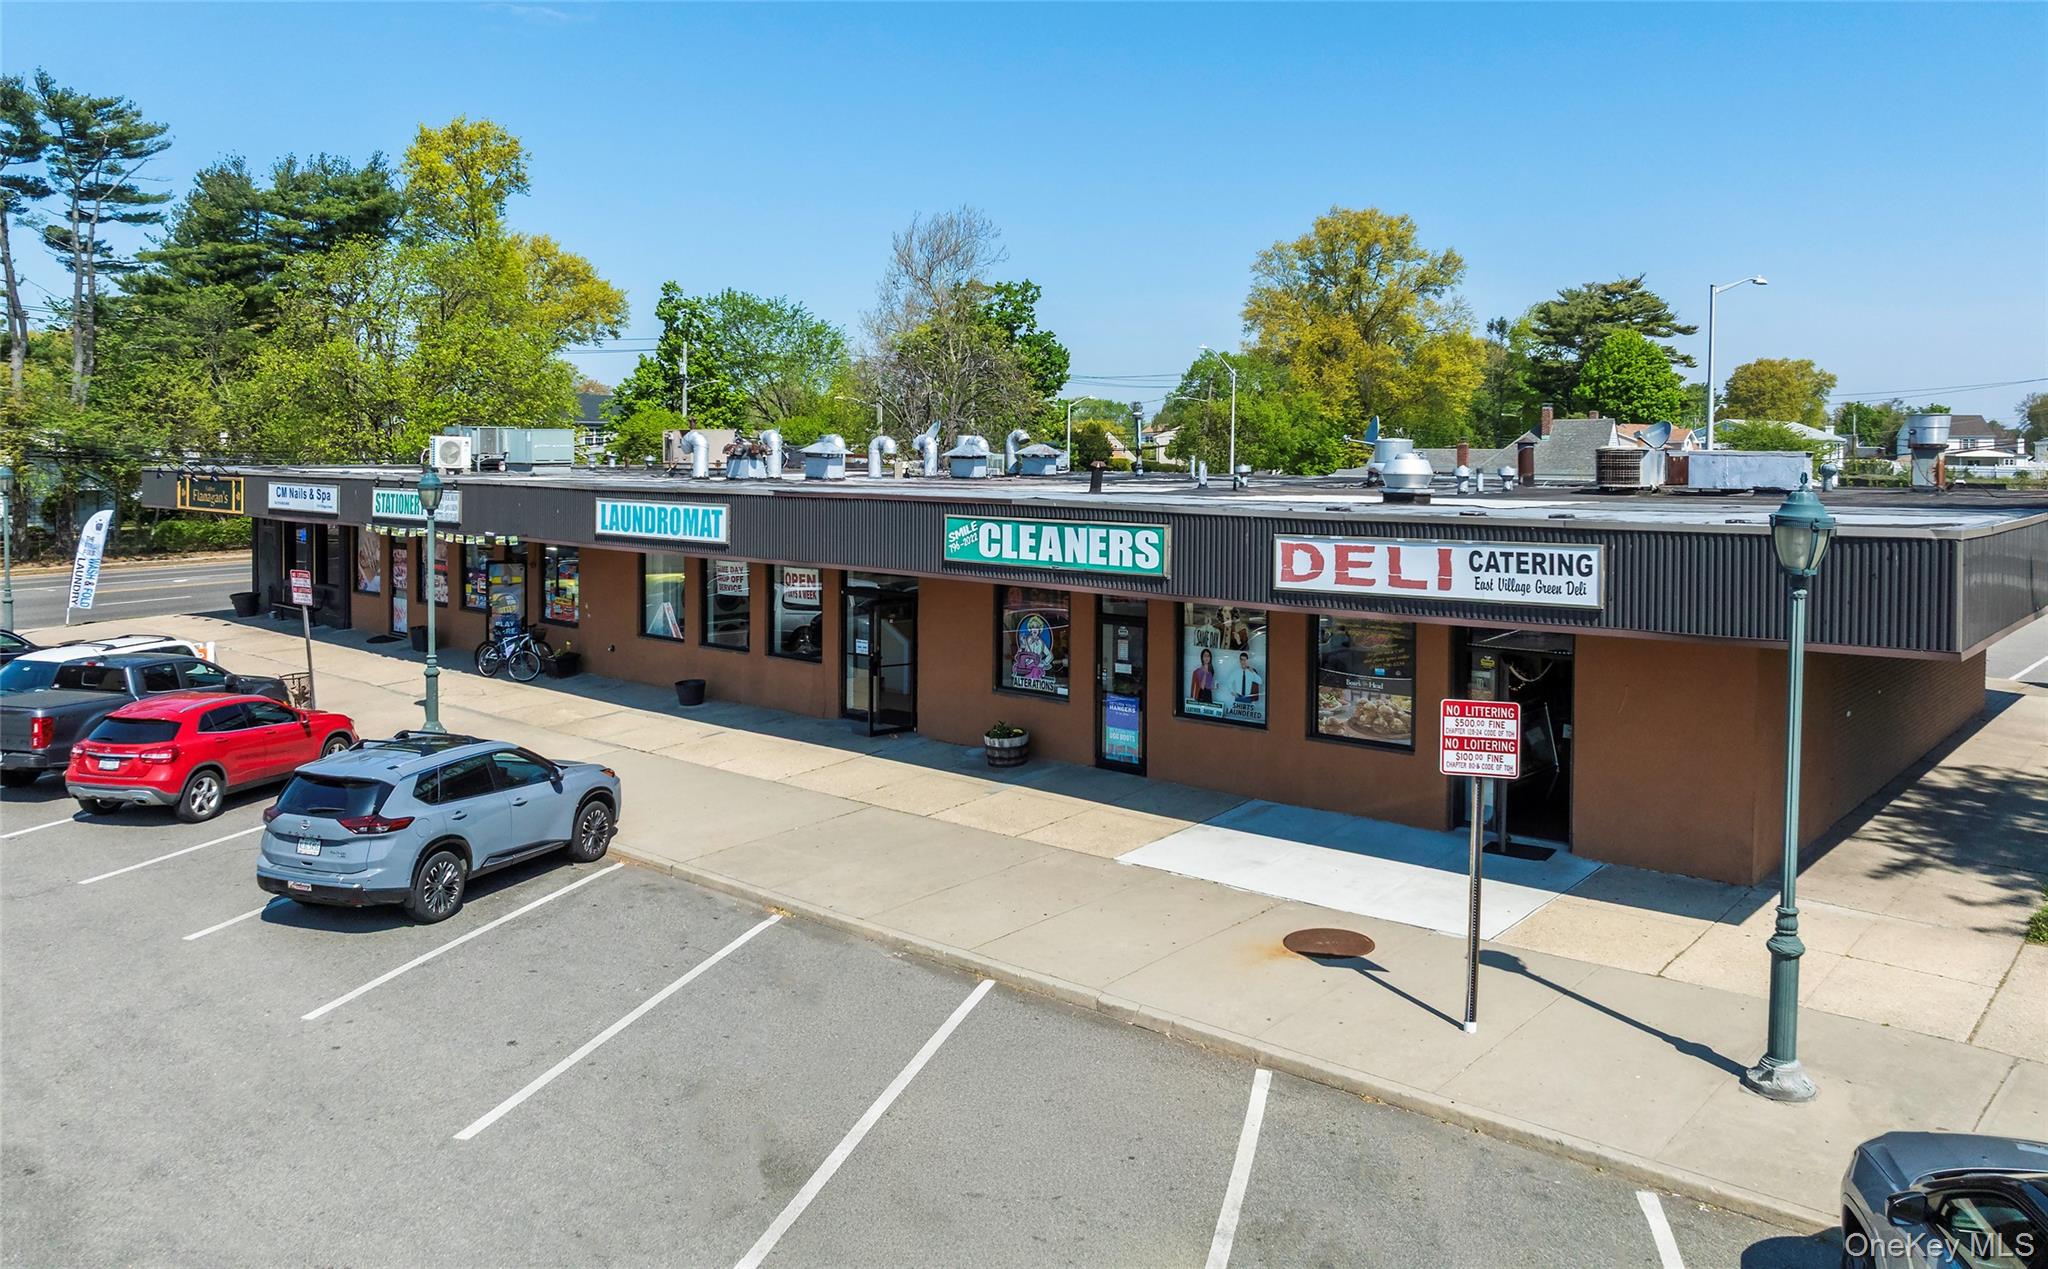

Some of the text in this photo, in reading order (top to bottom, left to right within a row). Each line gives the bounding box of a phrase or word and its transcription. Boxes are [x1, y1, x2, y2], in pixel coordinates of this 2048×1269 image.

[192, 489, 228, 507] Flanagan's
[276, 486, 331, 502] CM Nails & Spa
[600, 503, 723, 538] LAUNDROMAT
[948, 520, 978, 544] SMILE
[949, 532, 979, 554] 796-2022
[978, 522, 1160, 569] CLEANERS
[85, 558, 101, 580] WASH
[730, 566, 744, 574] DAY
[1280, 542, 1453, 591] DELI
[1468, 550, 1593, 577] CATERING
[71, 557, 86, 605] LAUNDRY
[731, 575, 744, 584] OFF
[785, 572, 816, 588] OPEN
[1474, 576, 1587, 596] East Village Green Deli
[80, 587, 93, 608] FOLD
[1013, 677, 1055, 691] ALTERATIONS
[1225, 708, 1262, 719] LAUNDERED
[1232, 702, 1254, 711] SHIRTS
[1446, 704, 1515, 719] NO LITTERING
[1455, 718, 1506, 729] $500.00 FINE
[1446, 727, 1466, 735] CHAPTER
[1484, 729, 1496, 737] CODE
[1445, 738, 1515, 752] NO LOITERING
[1446, 761, 1467, 769] CHAPTER
[1481, 763, 1494, 771] CODE
[1487, 754, 1504, 763] FINE
